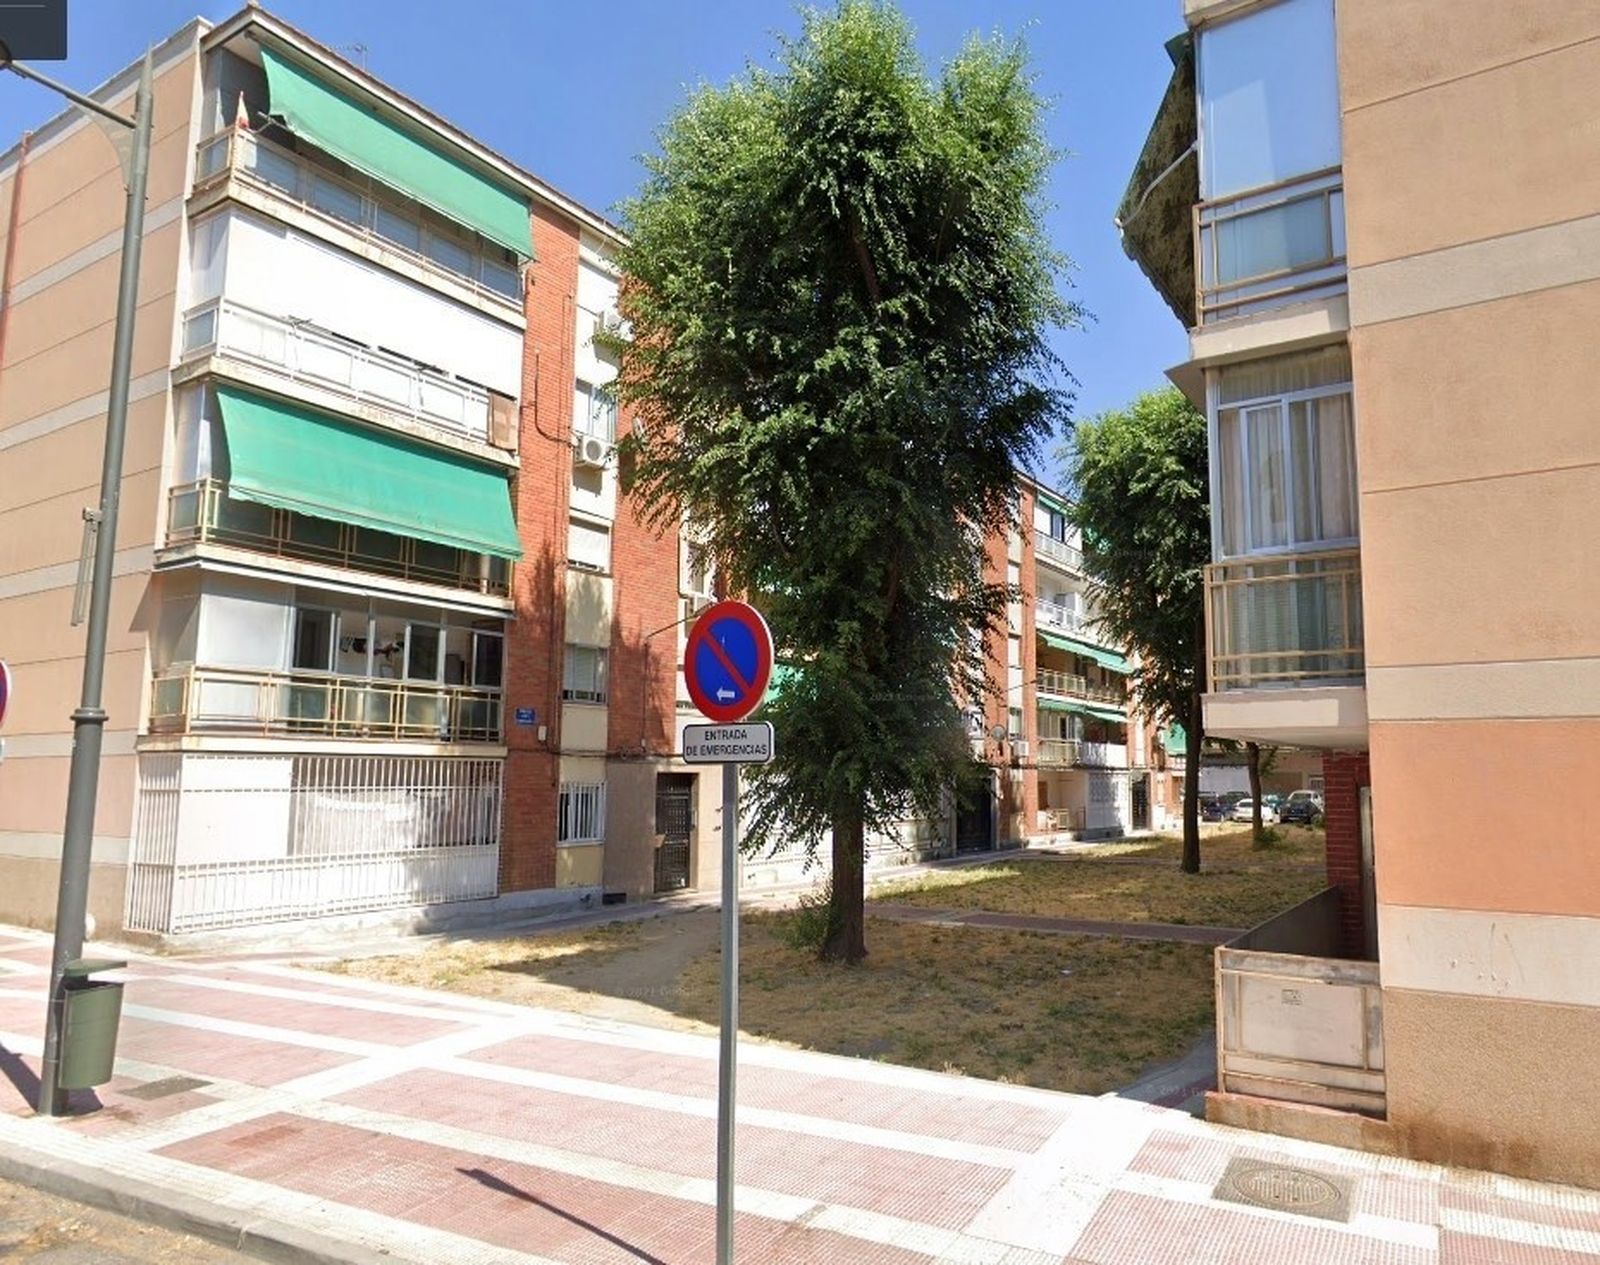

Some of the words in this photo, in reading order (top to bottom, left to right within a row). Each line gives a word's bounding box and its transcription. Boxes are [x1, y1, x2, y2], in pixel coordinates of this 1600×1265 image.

[704, 729, 748, 741] ENTRADA
[686, 745, 698, 757] DE
[700, 744, 768, 756] EMERGENCIAS
